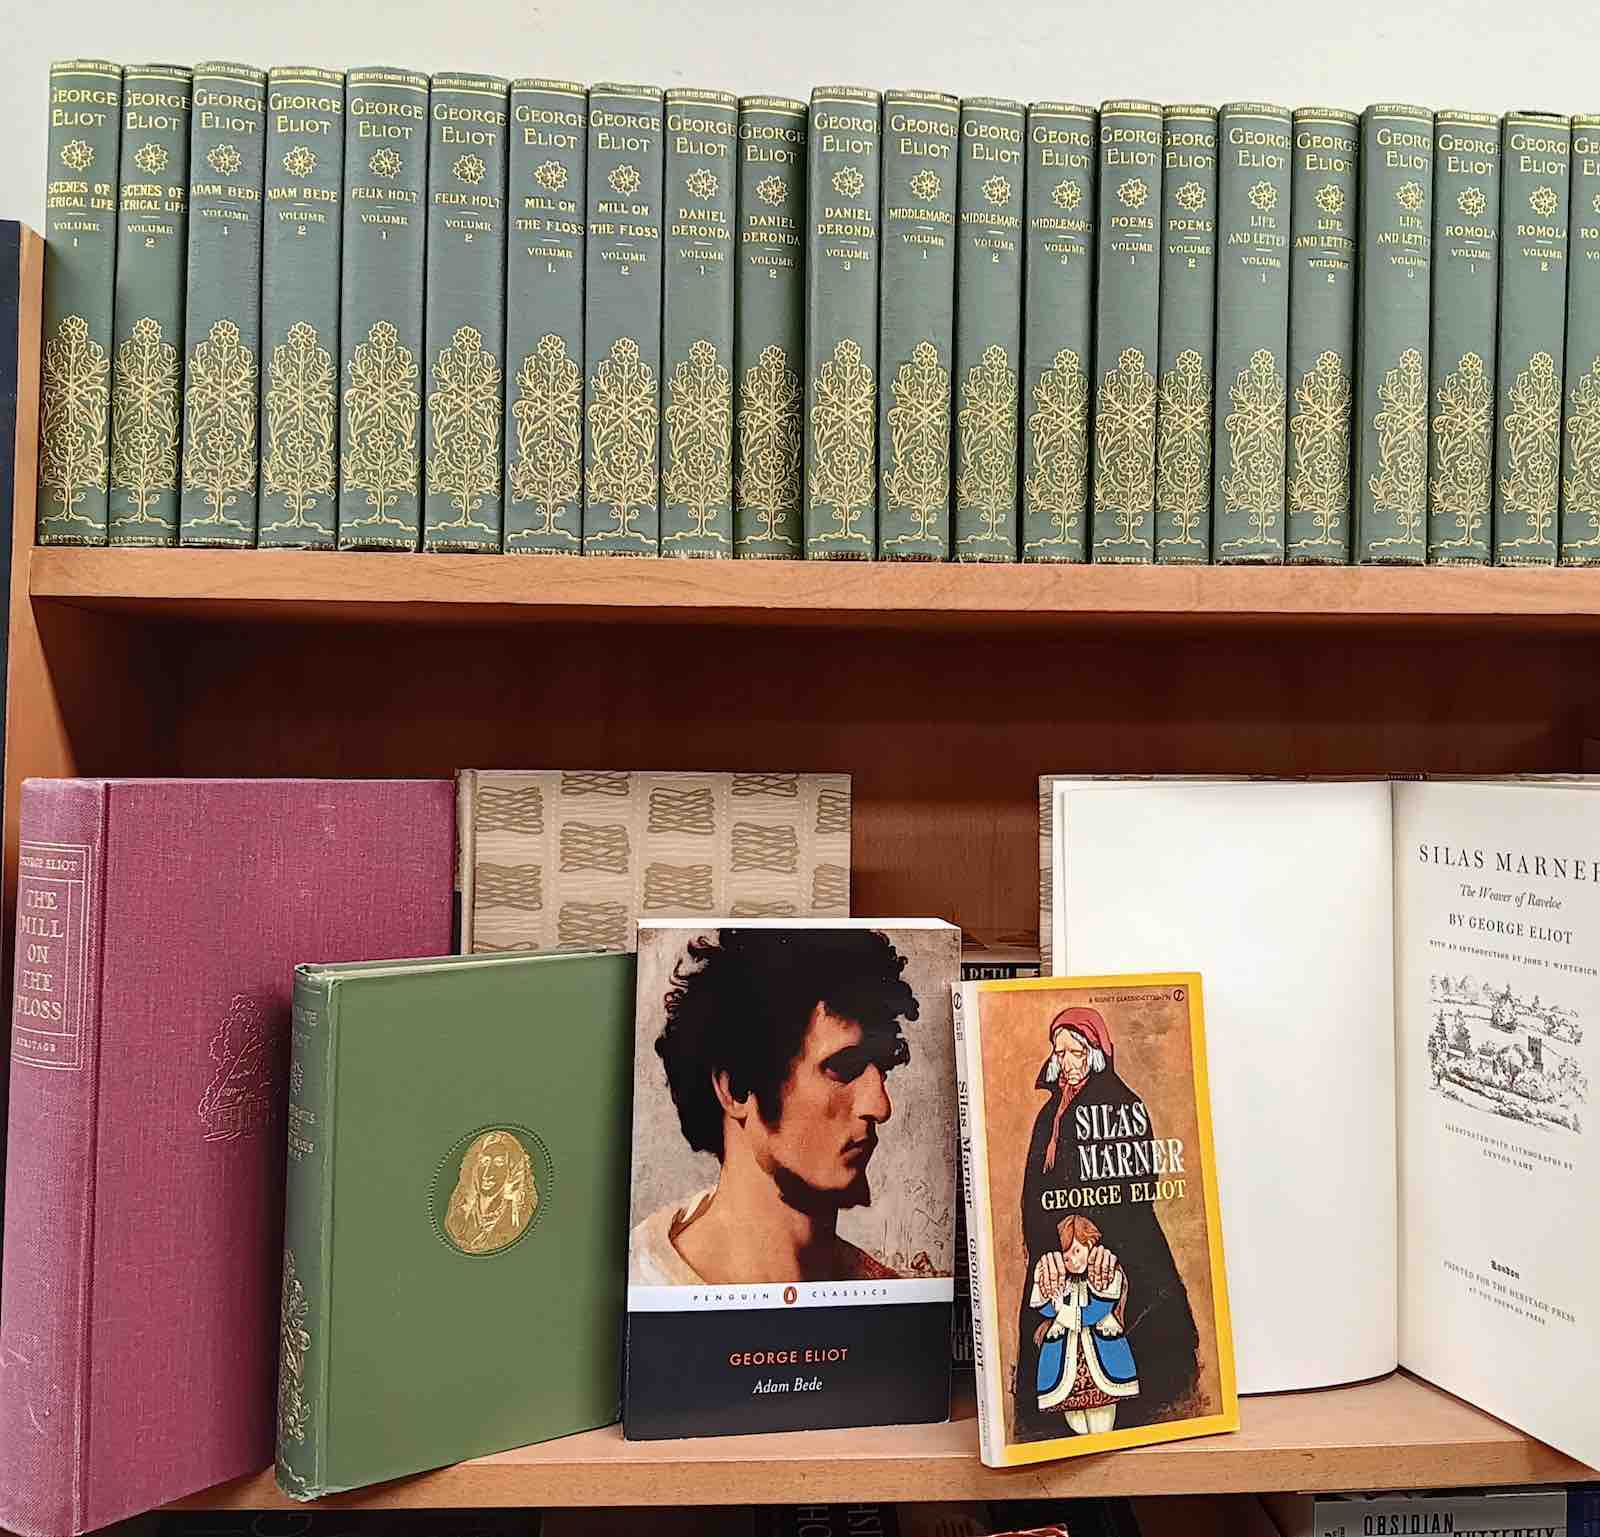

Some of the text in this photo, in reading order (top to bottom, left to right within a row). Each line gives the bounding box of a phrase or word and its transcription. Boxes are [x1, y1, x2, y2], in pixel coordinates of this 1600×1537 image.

[270, 93, 342, 114] GEORGE
[351, 98, 423, 119] GEORGE
[52, 109, 106, 127] ELIOT
[127, 112, 180, 130] ELIOT
[202, 112, 256, 133] ELIOT
[434, 104, 507, 126] GEORGE
[591, 110, 660, 131] GEORGE
[277, 116, 332, 135] ELIOT
[360, 121, 413, 140] ELIOT
[442, 127, 497, 145] ELIOT
[524, 128, 578, 148] ELIOT
[598, 133, 651, 152] ELIOT
[676, 138, 728, 157] ELIOT
[823, 136, 873, 155] ELIOT
[900, 139, 951, 159] ELIOT
[746, 146, 795, 163] ELIOT
[972, 144, 1020, 164] ELIOT
[1042, 149, 1089, 168] ELIOT
[1107, 149, 1156, 166] ELIOT
[1166, 153, 1214, 169] ELIOT
[1238, 150, 1284, 169] ELIOT
[1387, 151, 1429, 171] ELIOT
[1448, 156, 1494, 176] ELIOT
[1520, 156, 1566, 176] ELIOT
[48, 182, 111, 194] SCENES OF
[122, 185, 184, 197] SCENES OF
[191, 185, 222, 195] ADAM
[268, 188, 337, 202] ADAM BEDE
[352, 188, 418, 203] FELIX HOLT
[91, 198, 113, 210] LIFE
[435, 193, 500, 209] FELIX HOLT
[524, 199, 576, 213] MILL ON
[598, 203, 649, 216] MILL ON
[680, 209, 726, 223] DANIEL
[825, 208, 871, 221] DANIEL
[516, 219, 584, 236] THE FLOSS
[750, 216, 795, 229] DANIEL
[962, 213, 1020, 228] MIDDLEMARC
[1112, 218, 1153, 229] POEMS
[1169, 220, 1213, 231] POEMS
[1251, 216, 1276, 228] LIFE
[1318, 219, 1343, 231] LIFE
[223, 227, 229, 235] 1
[297, 225, 307, 236] 2
[381, 231, 388, 240] 1
[464, 233, 473, 242] 2
[591, 225, 658, 239] THE FLOSS
[672, 225, 731, 240] DERONDA
[817, 224, 876, 238] DERONDA
[1446, 226, 1496, 240] ROMOLA
[1518, 225, 1567, 240] ROMOLA
[73, 237, 79, 247] 1
[145, 238, 155, 248] 2
[742, 233, 800, 245] DERONDA
[1228, 234, 1250, 245] AND
[1296, 238, 1317, 248] AND
[1377, 233, 1399, 244] AND
[922, 250, 928, 259] 1
[992, 254, 1000, 263] 2
[1131, 255, 1136, 264] 1
[621, 265, 630, 275] 2
[1188, 257, 1196, 268] 2
[1471, 264, 1474, 272] 1
[1541, 263, 1548, 272] 2
[699, 266, 705, 275] 1
[769, 269, 777, 279] 2
[1261, 272, 1266, 282] 1
[1328, 272, 1335, 283] 2
[1418, 844, 1484, 868] SILAS
[27, 890, 58, 910] THE
[1460, 883, 1562, 909] The Weaver of Raveloe
[1449, 913, 1573, 944] BY GEORGE ELIOT
[28, 944, 49, 964] ON
[23, 970, 53, 992] THE
[1075, 1102, 1147, 1140] SILAS
[958, 1080, 973, 1209] Silas Marner
[1077, 1138, 1185, 1181] MARNER
[1042, 1180, 1186, 1210] GEORGE ELIOT
[693, 1288, 888, 1302] PENGUIN CLASSICS
[969, 1237, 983, 1372] GEORGE ELIOT
[729, 1349, 848, 1366] GEORGE ELIOT
[753, 1377, 823, 1394] Adam Bede
[1364, 1514, 1454, 1536] OBSIDIAN
